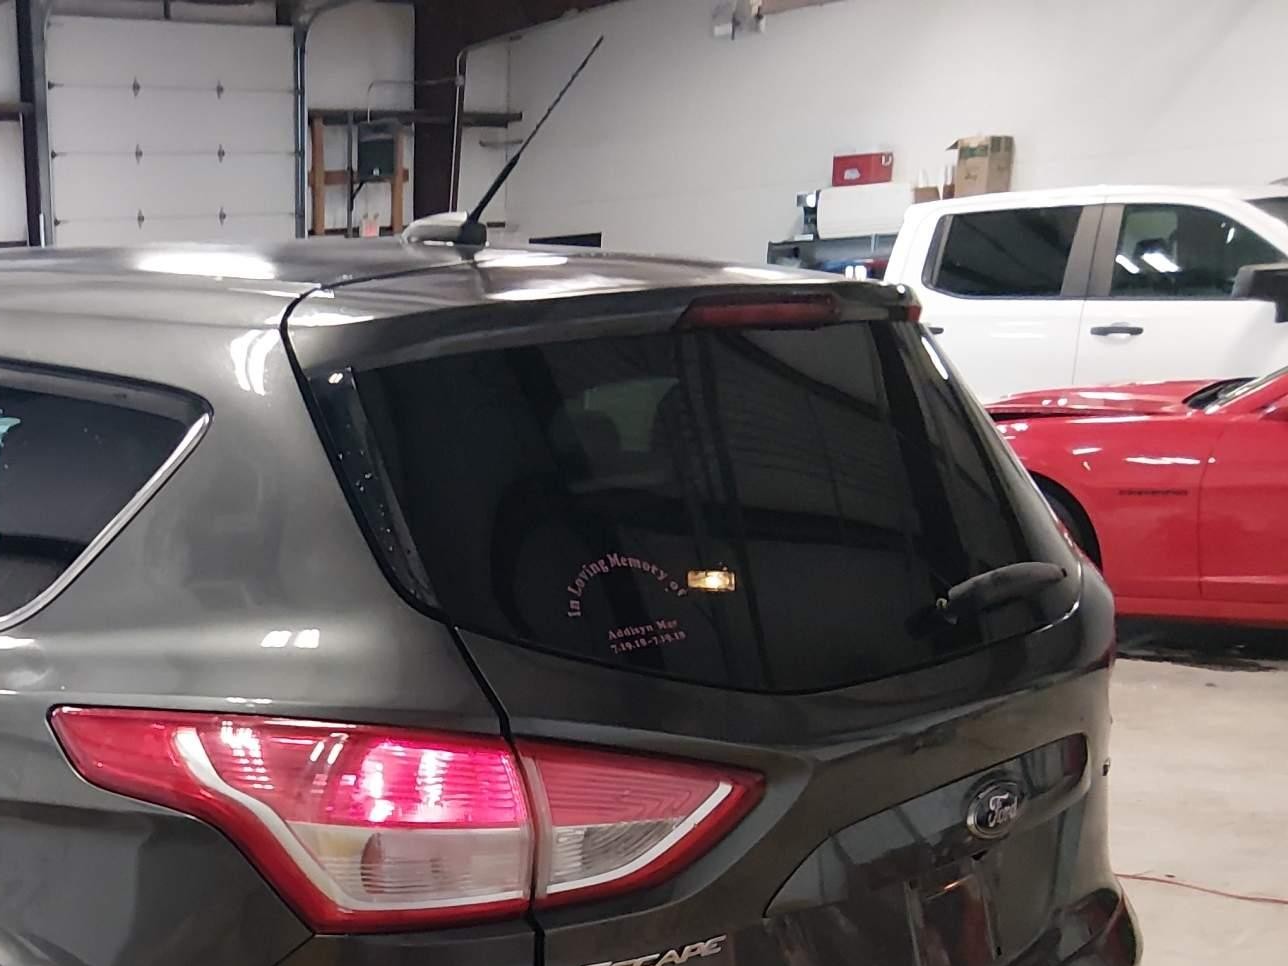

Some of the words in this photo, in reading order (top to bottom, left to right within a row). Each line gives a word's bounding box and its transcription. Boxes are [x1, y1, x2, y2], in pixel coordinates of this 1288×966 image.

[567, 558, 610, 597] Loving
[606, 552, 668, 581] Memory
[567, 599, 581, 617] In
[988, 792, 1017, 828] Ford
